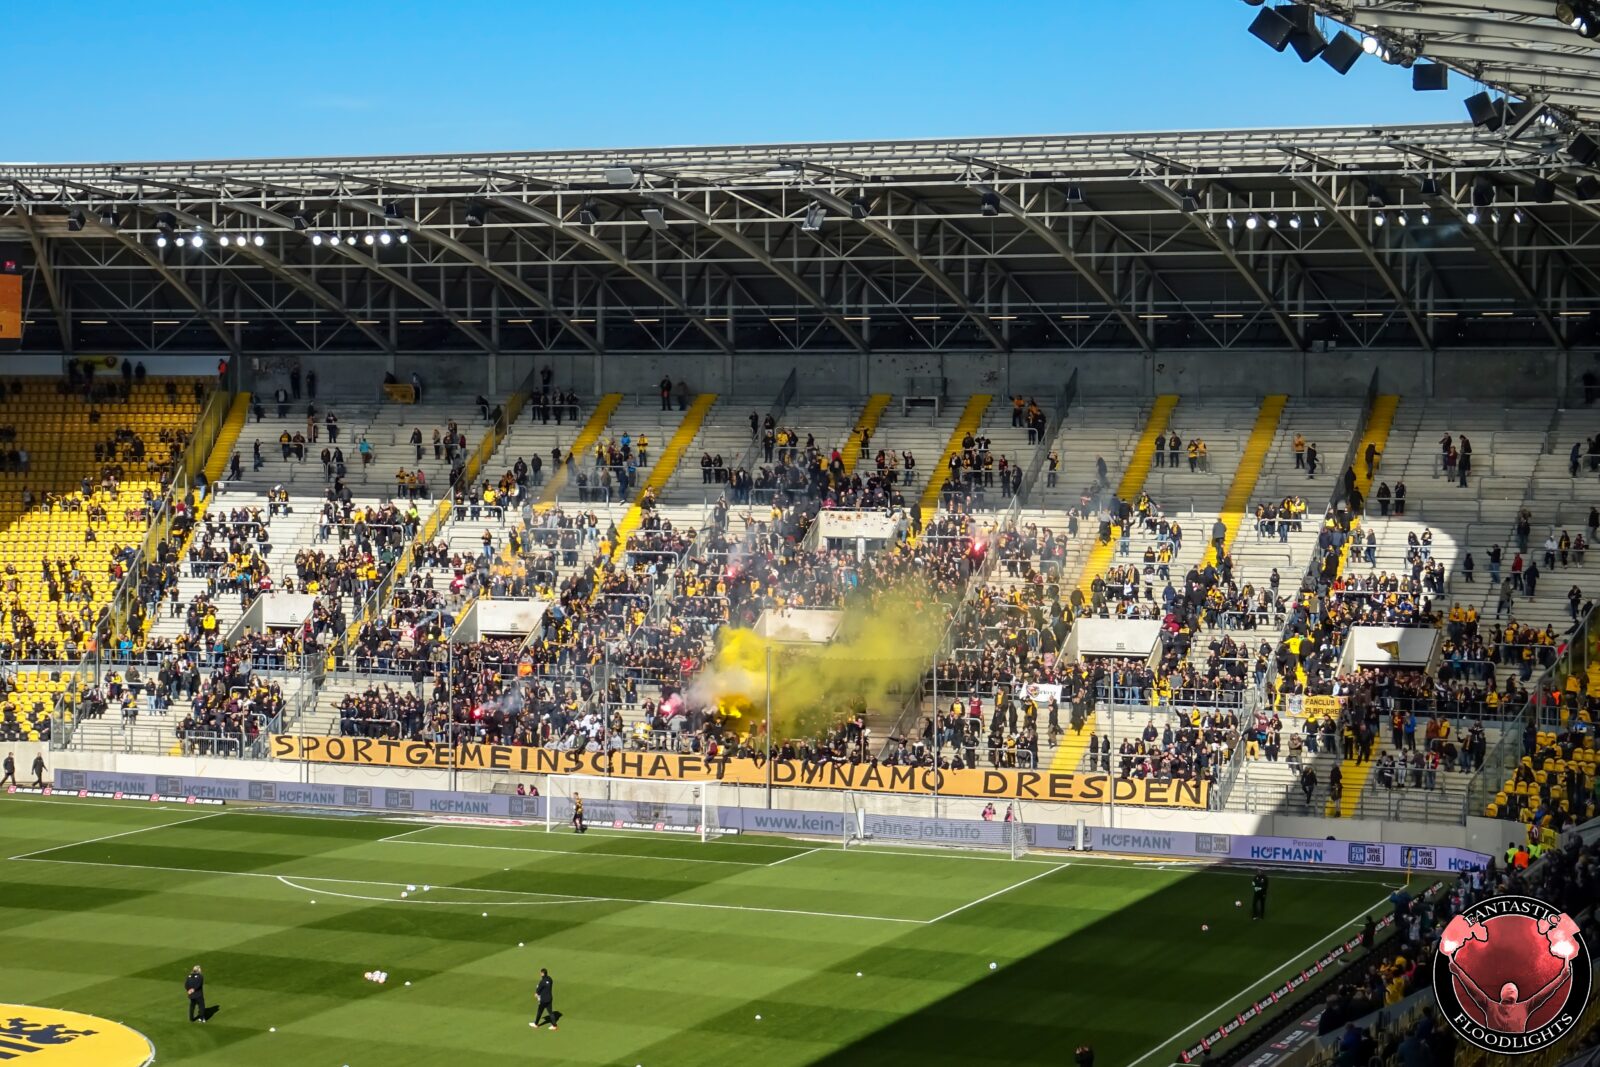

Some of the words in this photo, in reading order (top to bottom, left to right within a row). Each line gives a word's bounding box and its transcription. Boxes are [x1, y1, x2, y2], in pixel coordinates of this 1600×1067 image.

[275, 735, 732, 780] SPORTGEMEINSCHAFT
[773, 760, 945, 791] DYNAMO
[983, 771, 1201, 804] DRESDEN
[555, 806, 616, 820] HOMANN
[755, 814, 981, 840] www.kein-fa-ohne-job.info
[1293, 839, 1324, 848] Personal
[1251, 846, 1323, 862] HOFMANN
